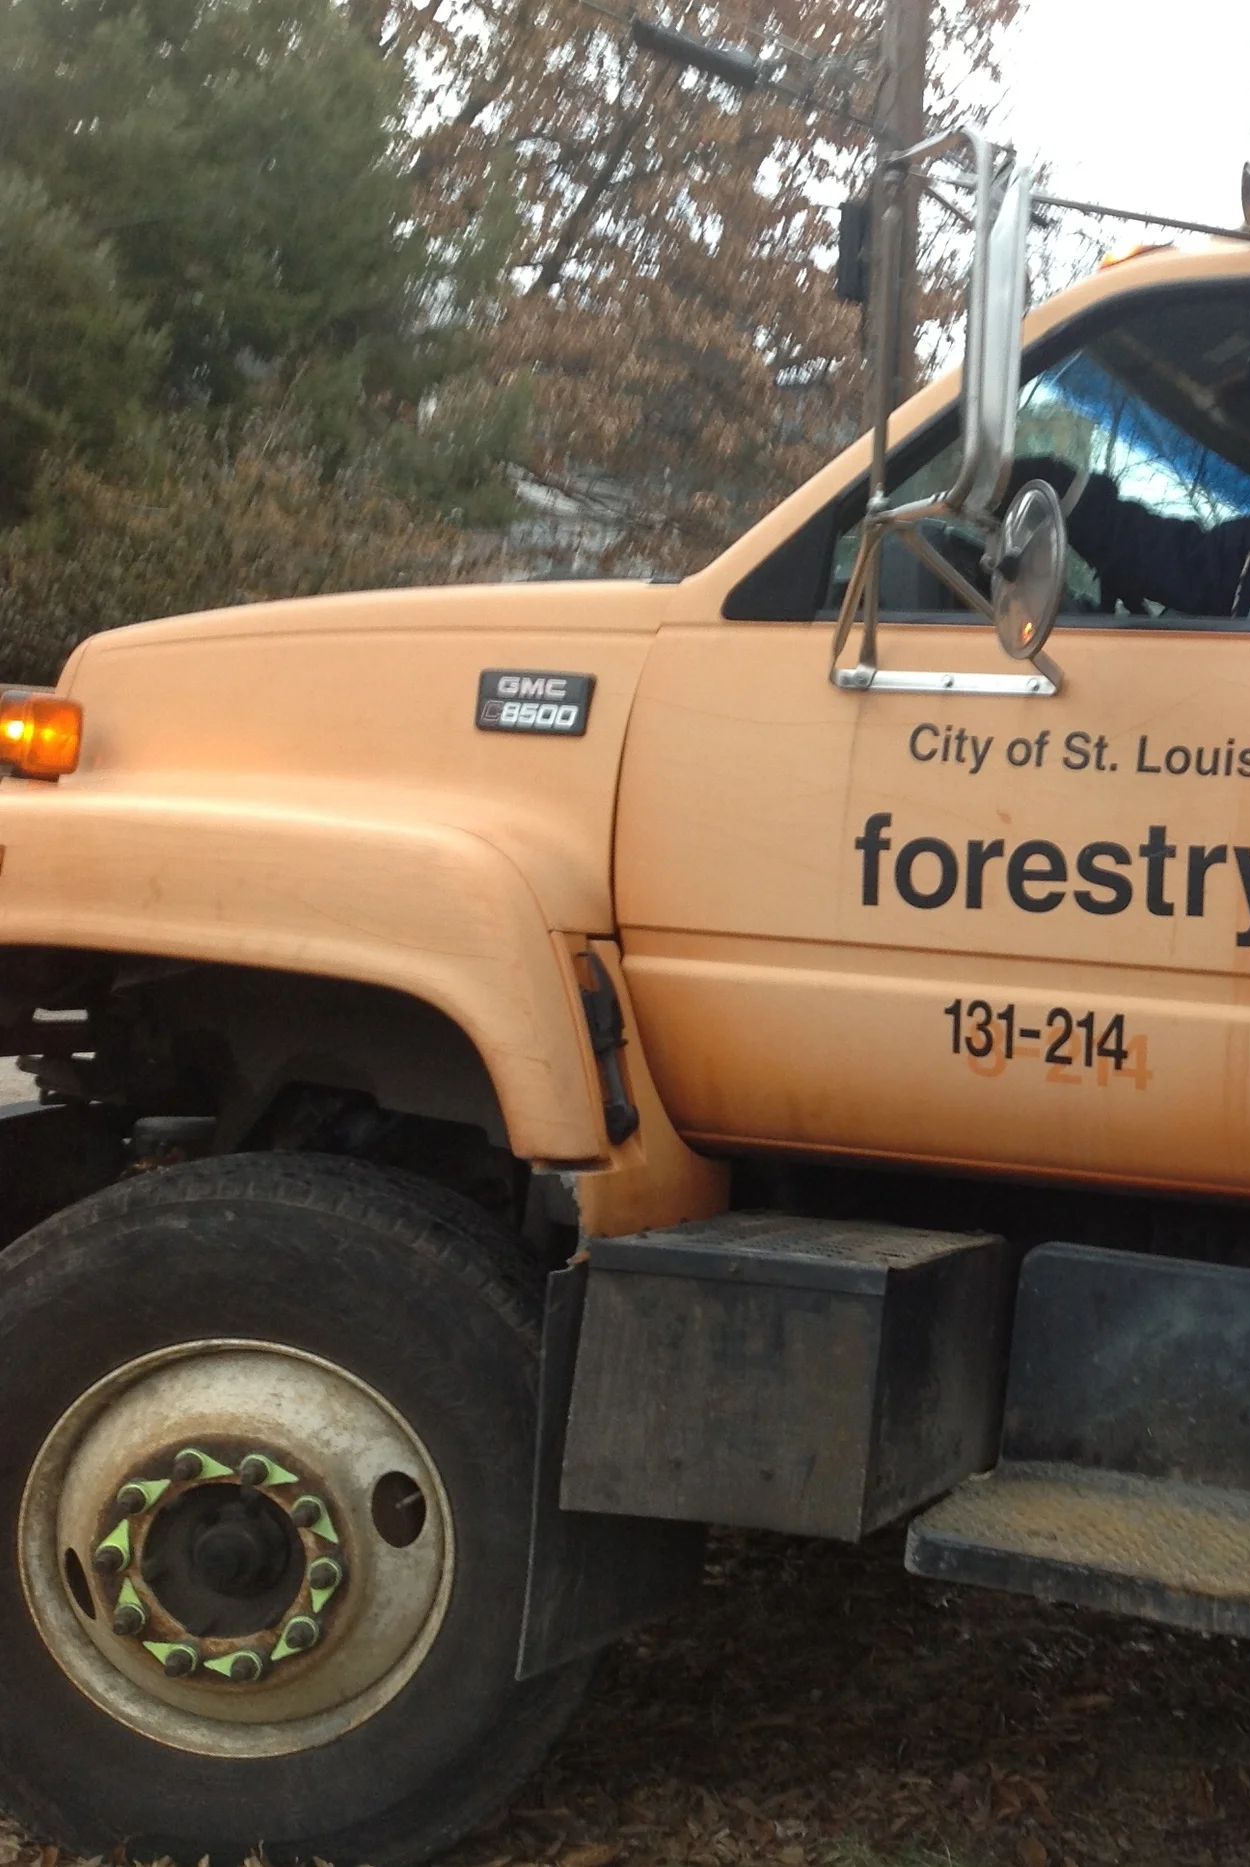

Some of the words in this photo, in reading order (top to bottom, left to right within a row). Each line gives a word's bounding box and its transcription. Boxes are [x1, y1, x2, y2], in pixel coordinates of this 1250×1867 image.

[497, 676, 567, 700] GMC
[909, 722, 994, 775] City
[1006, 730, 1050, 768] of
[1062, 730, 1118, 772] St.
[944, 998, 1129, 1073] 131-214
